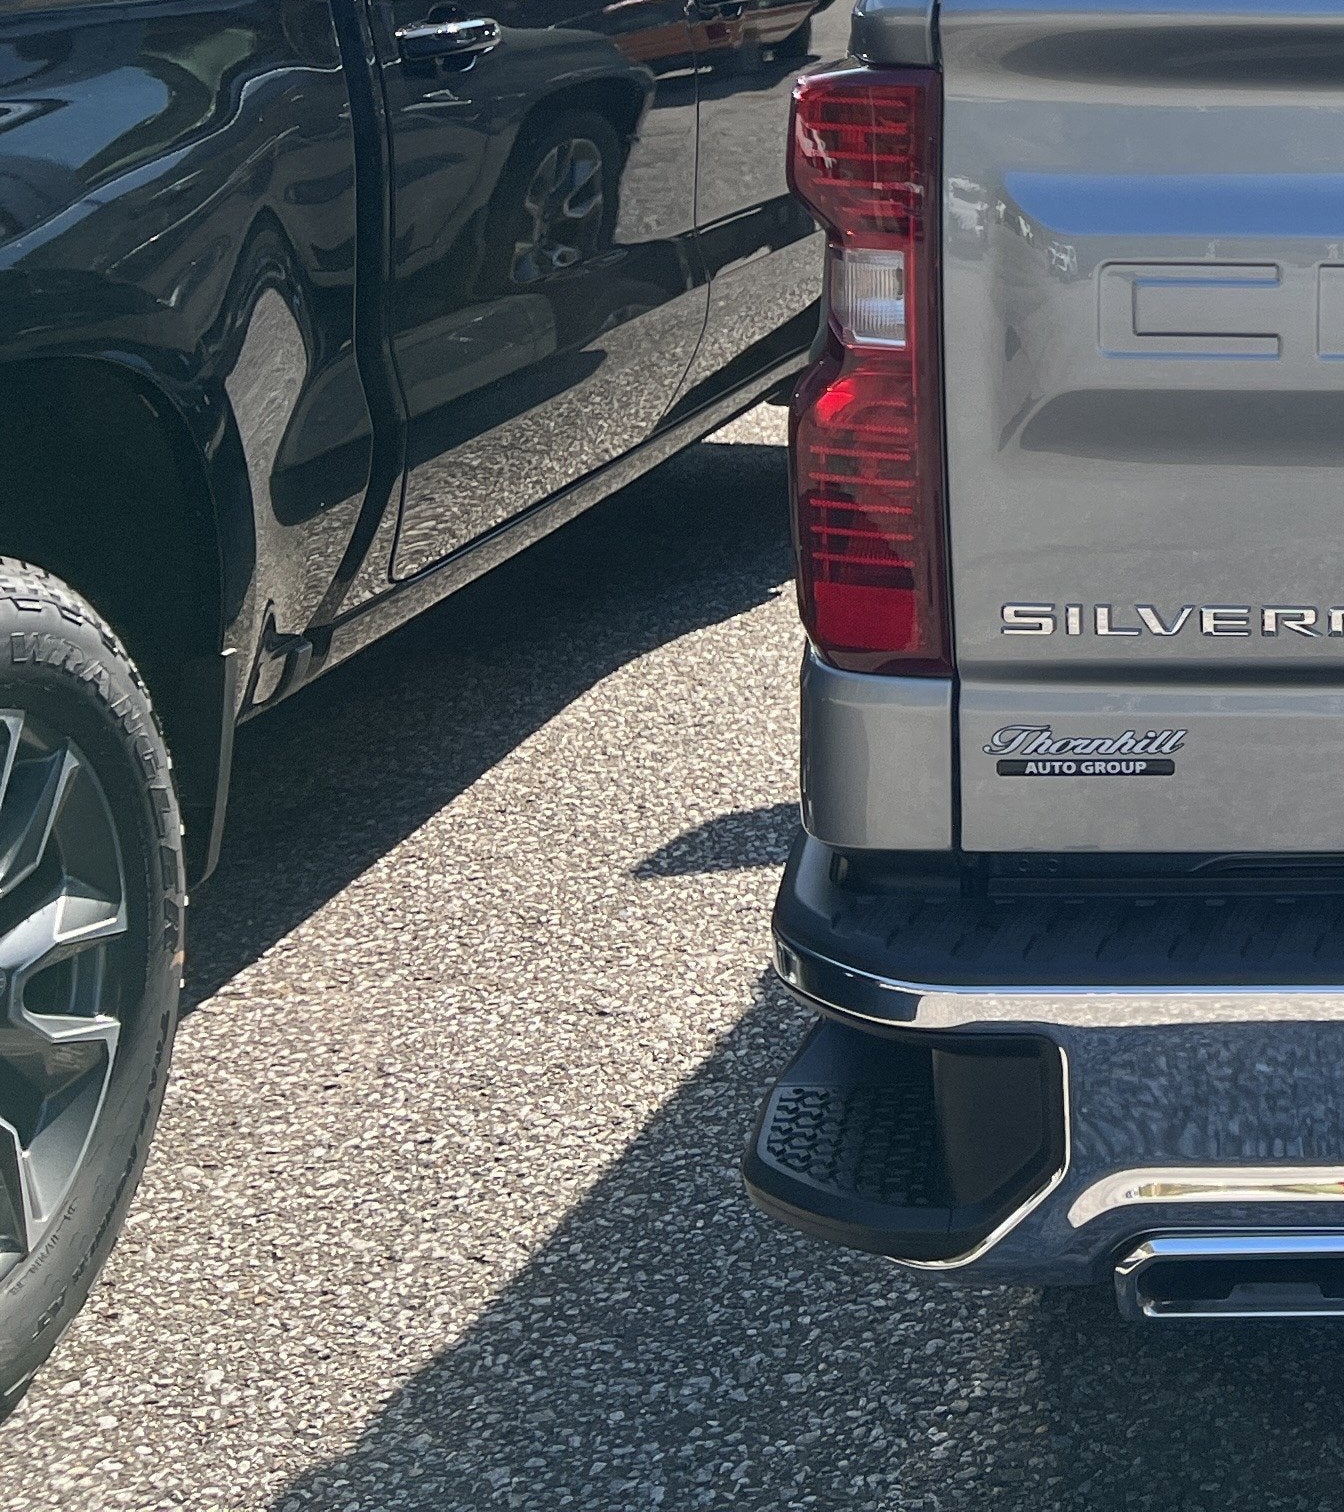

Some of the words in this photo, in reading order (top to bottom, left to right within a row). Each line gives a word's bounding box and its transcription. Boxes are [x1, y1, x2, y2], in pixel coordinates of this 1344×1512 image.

[982, 724, 1188, 755] Thornhill
[1024, 761, 1077, 774] AUTO
[1080, 761, 1148, 774] GROUP
[10, 631, 179, 953] WRANGLER
